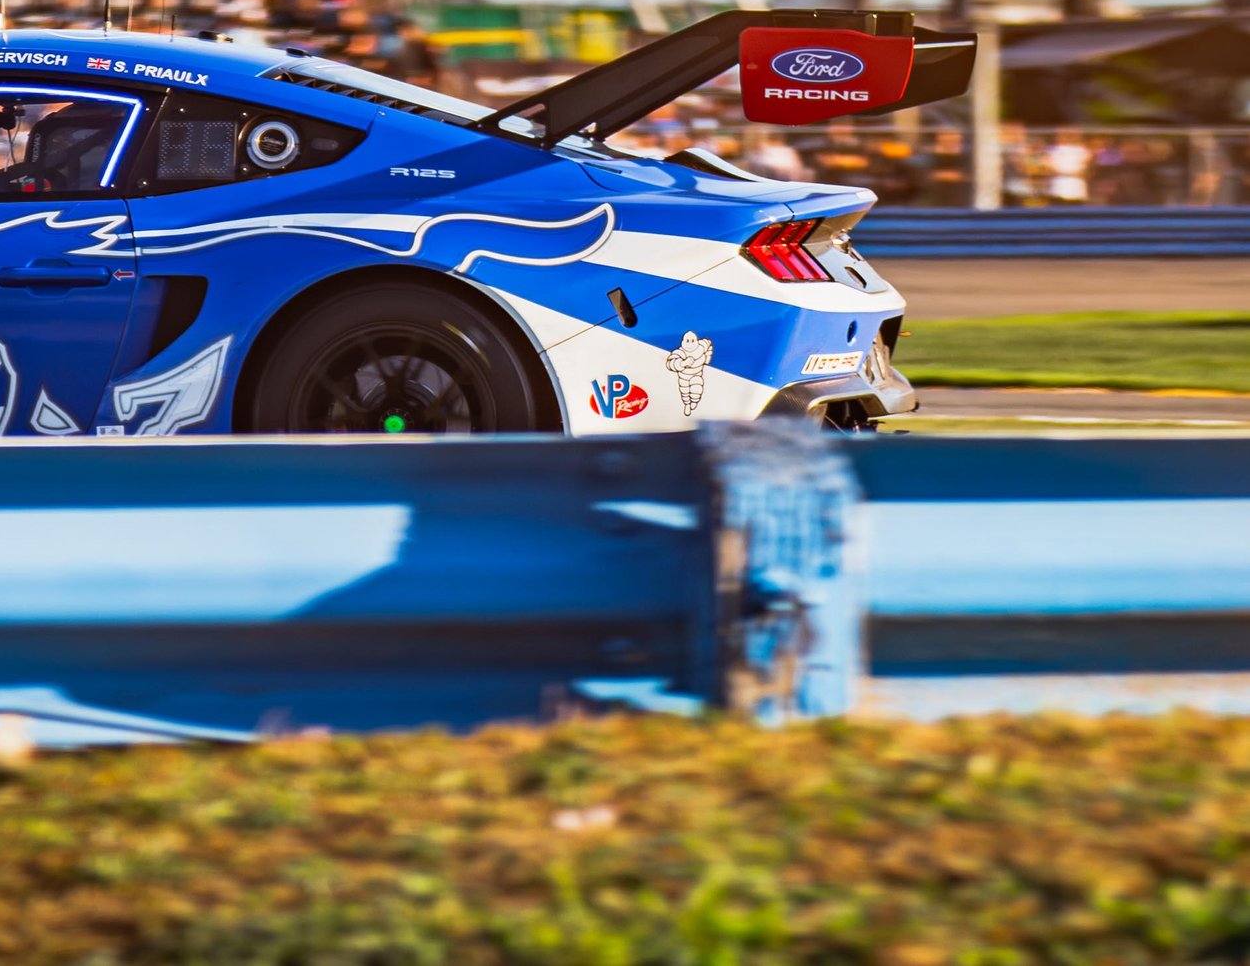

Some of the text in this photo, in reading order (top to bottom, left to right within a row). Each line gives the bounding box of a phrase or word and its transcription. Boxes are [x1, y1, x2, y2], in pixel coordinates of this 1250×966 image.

[114, 62, 210, 87] S. PRIAULX
[789, 52, 845, 77] Ford
[764, 88, 869, 101] RACING
[591, 374, 630, 419] VP
[616, 397, 649, 415] Racing
